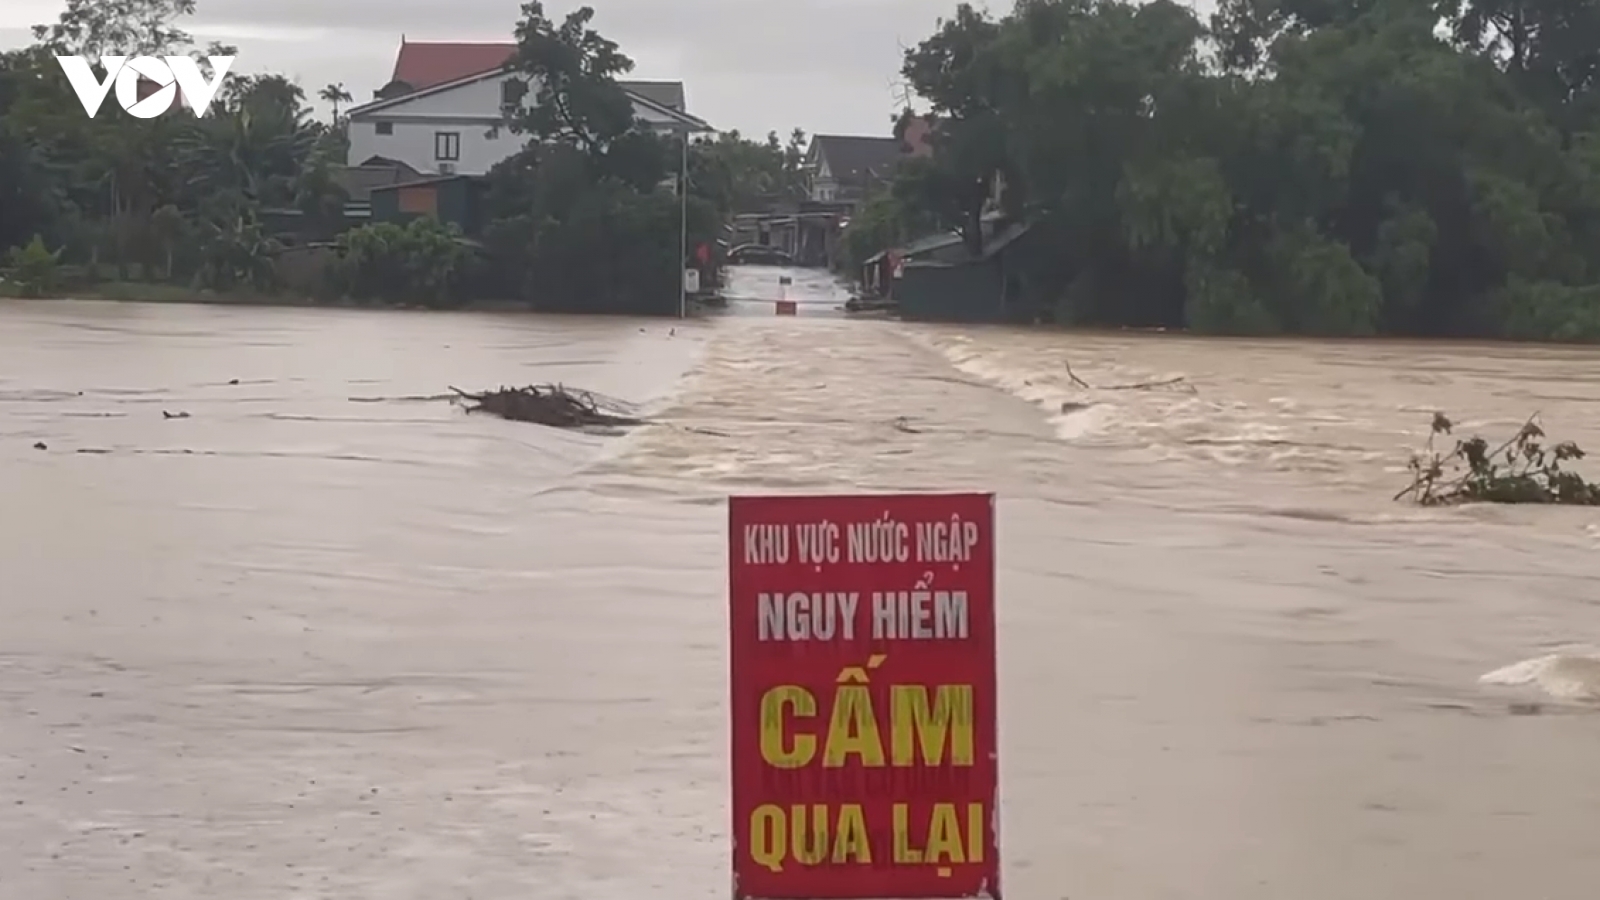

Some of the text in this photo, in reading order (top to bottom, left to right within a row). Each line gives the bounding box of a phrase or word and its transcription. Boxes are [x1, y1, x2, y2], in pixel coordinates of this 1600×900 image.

[744, 510, 979, 573] KHU VỰC NƯỚC NGẬP
[758, 571, 969, 641] NGUY HIỂM
[760, 654, 974, 768] CẤM
[750, 802, 984, 877] QUA LẠI
